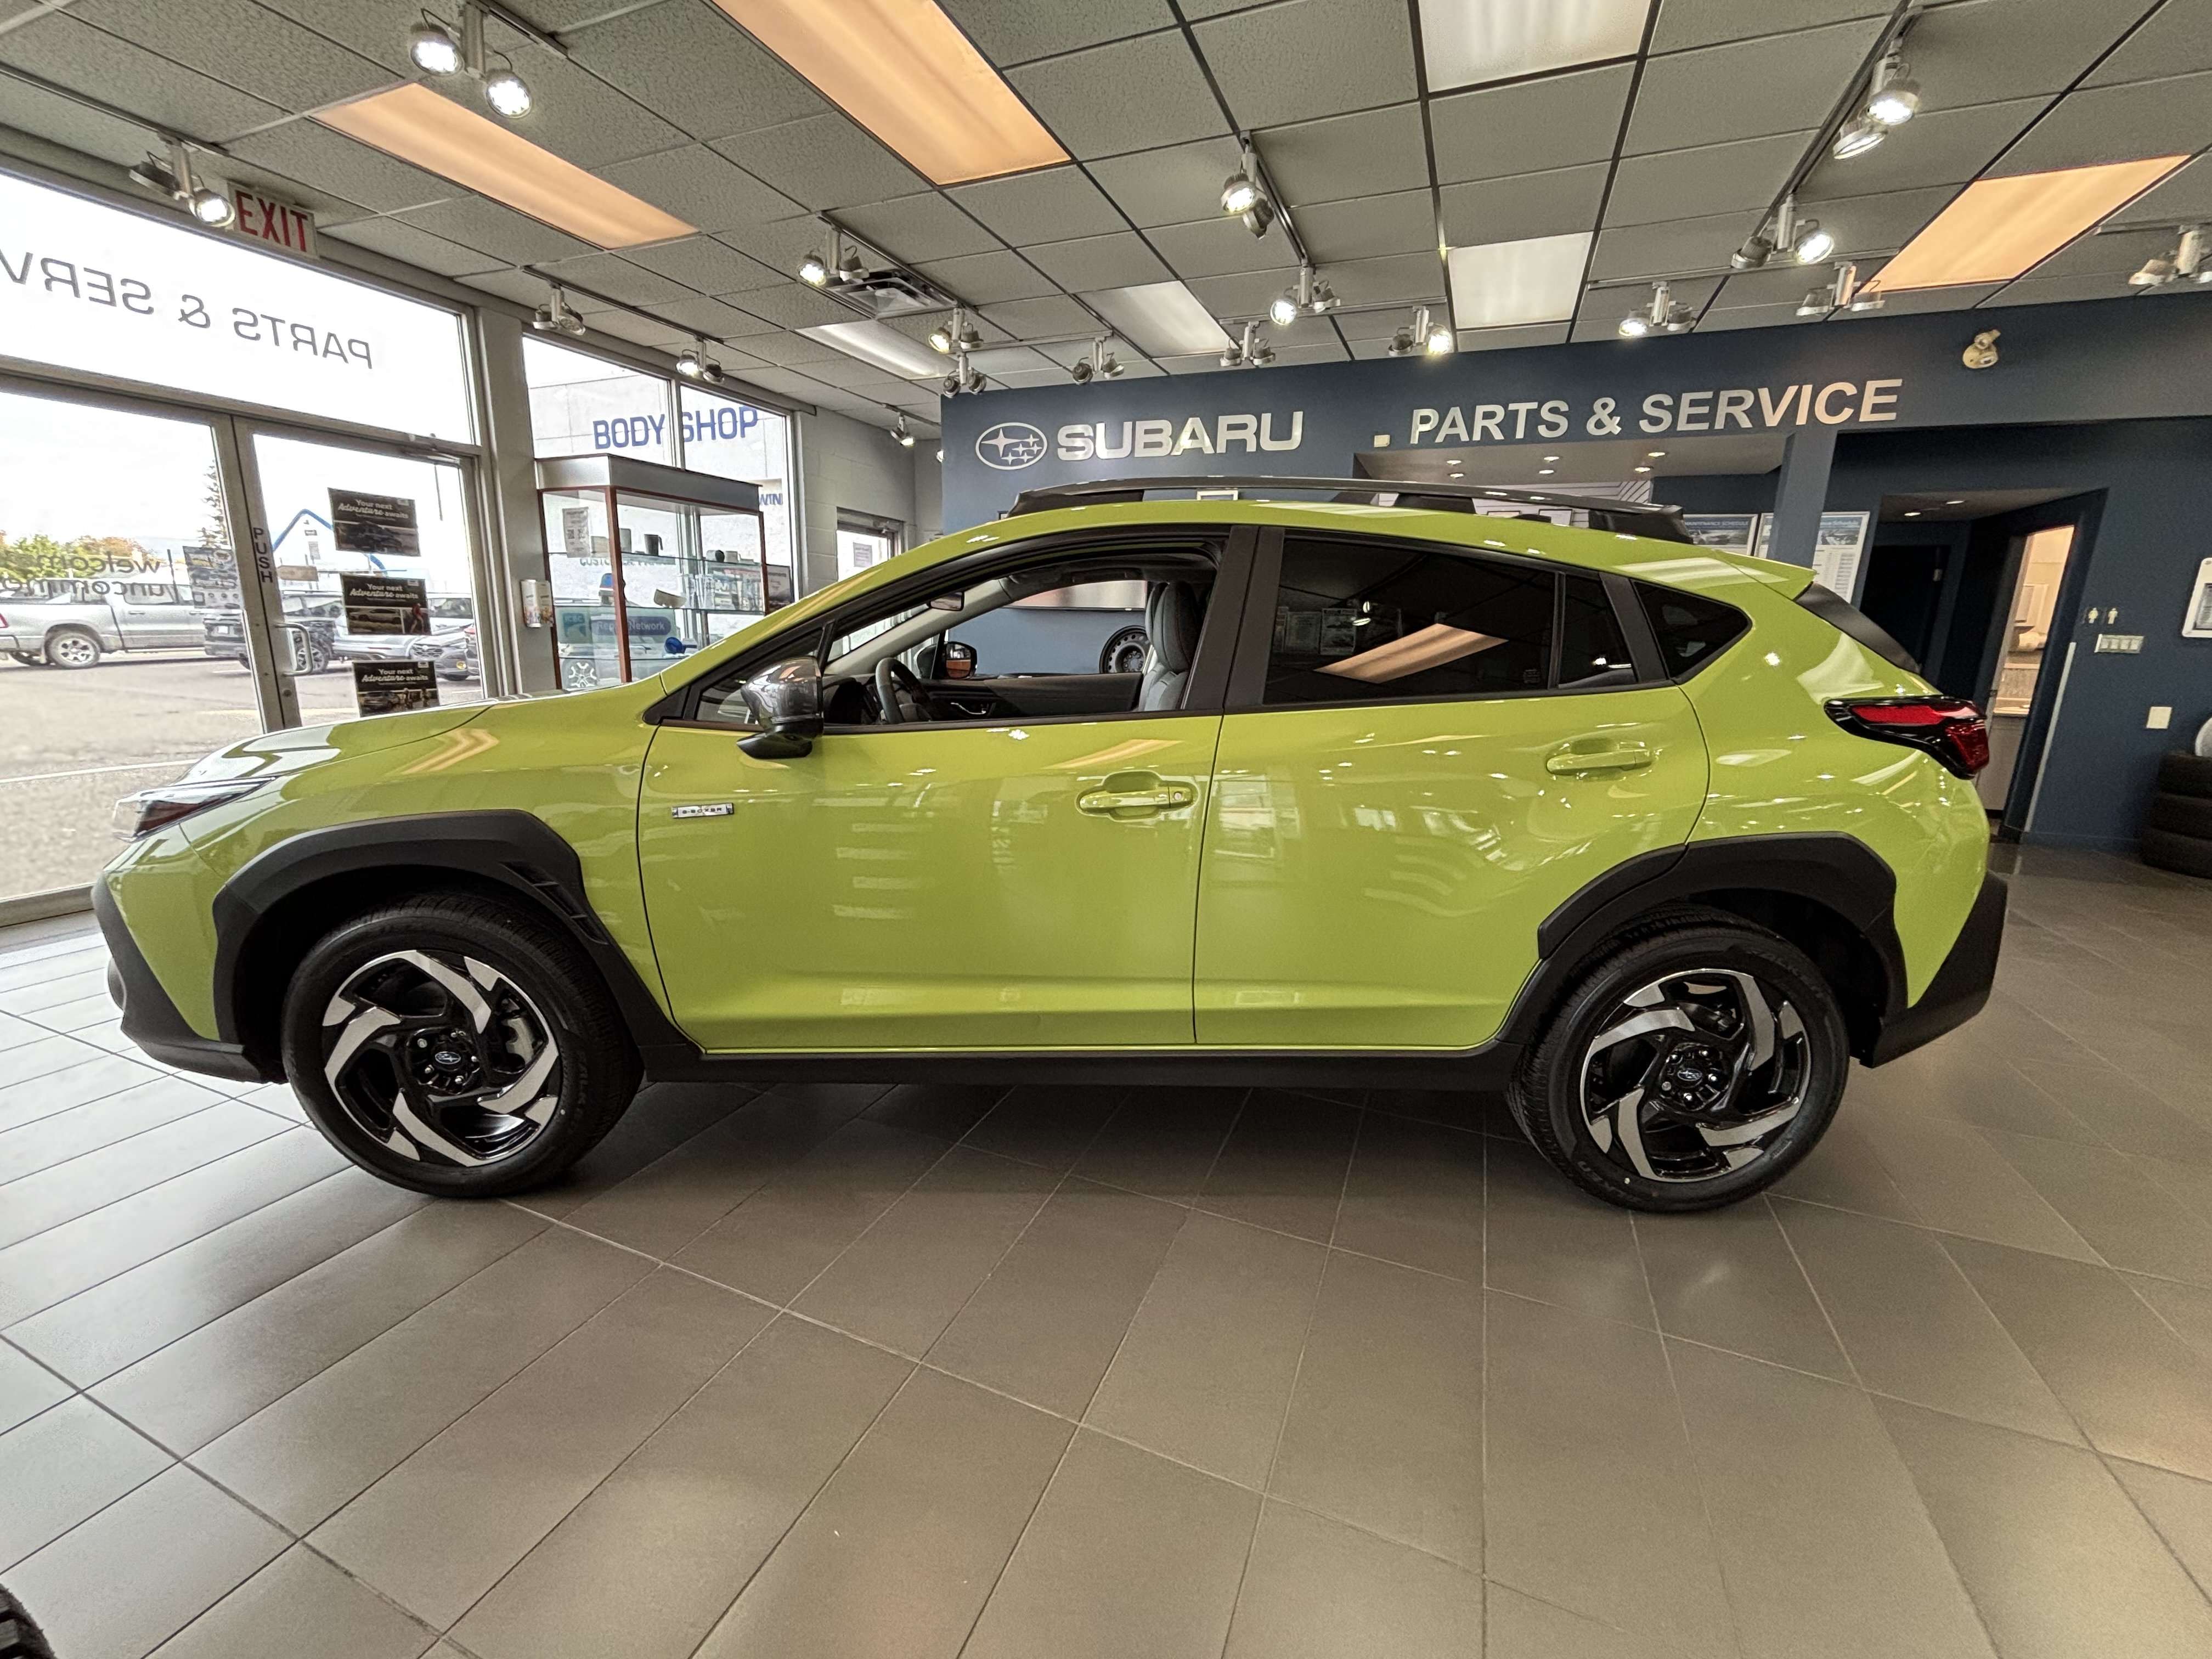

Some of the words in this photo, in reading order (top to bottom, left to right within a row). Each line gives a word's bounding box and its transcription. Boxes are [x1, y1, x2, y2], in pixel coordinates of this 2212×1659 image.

[235, 192, 308, 253] EXIT
[1410, 400, 1569, 444] PARTS
[1586, 397, 1622, 436] &
[1639, 379, 1903, 433] SERVICE
[592, 414, 665, 449] BODY
[682, 406, 758, 443] SHOP
[1057, 410, 1304, 461] SUBARU
[337, 502, 384, 516] Adventure
[385, 511, 409, 520] awaits
[356, 499, 374, 507] Your
[253, 527, 273, 583] PUSH
[349, 588, 394, 597] Adventure
[630, 620, 665, 630] Network
[361, 674, 405, 682] Adventure
